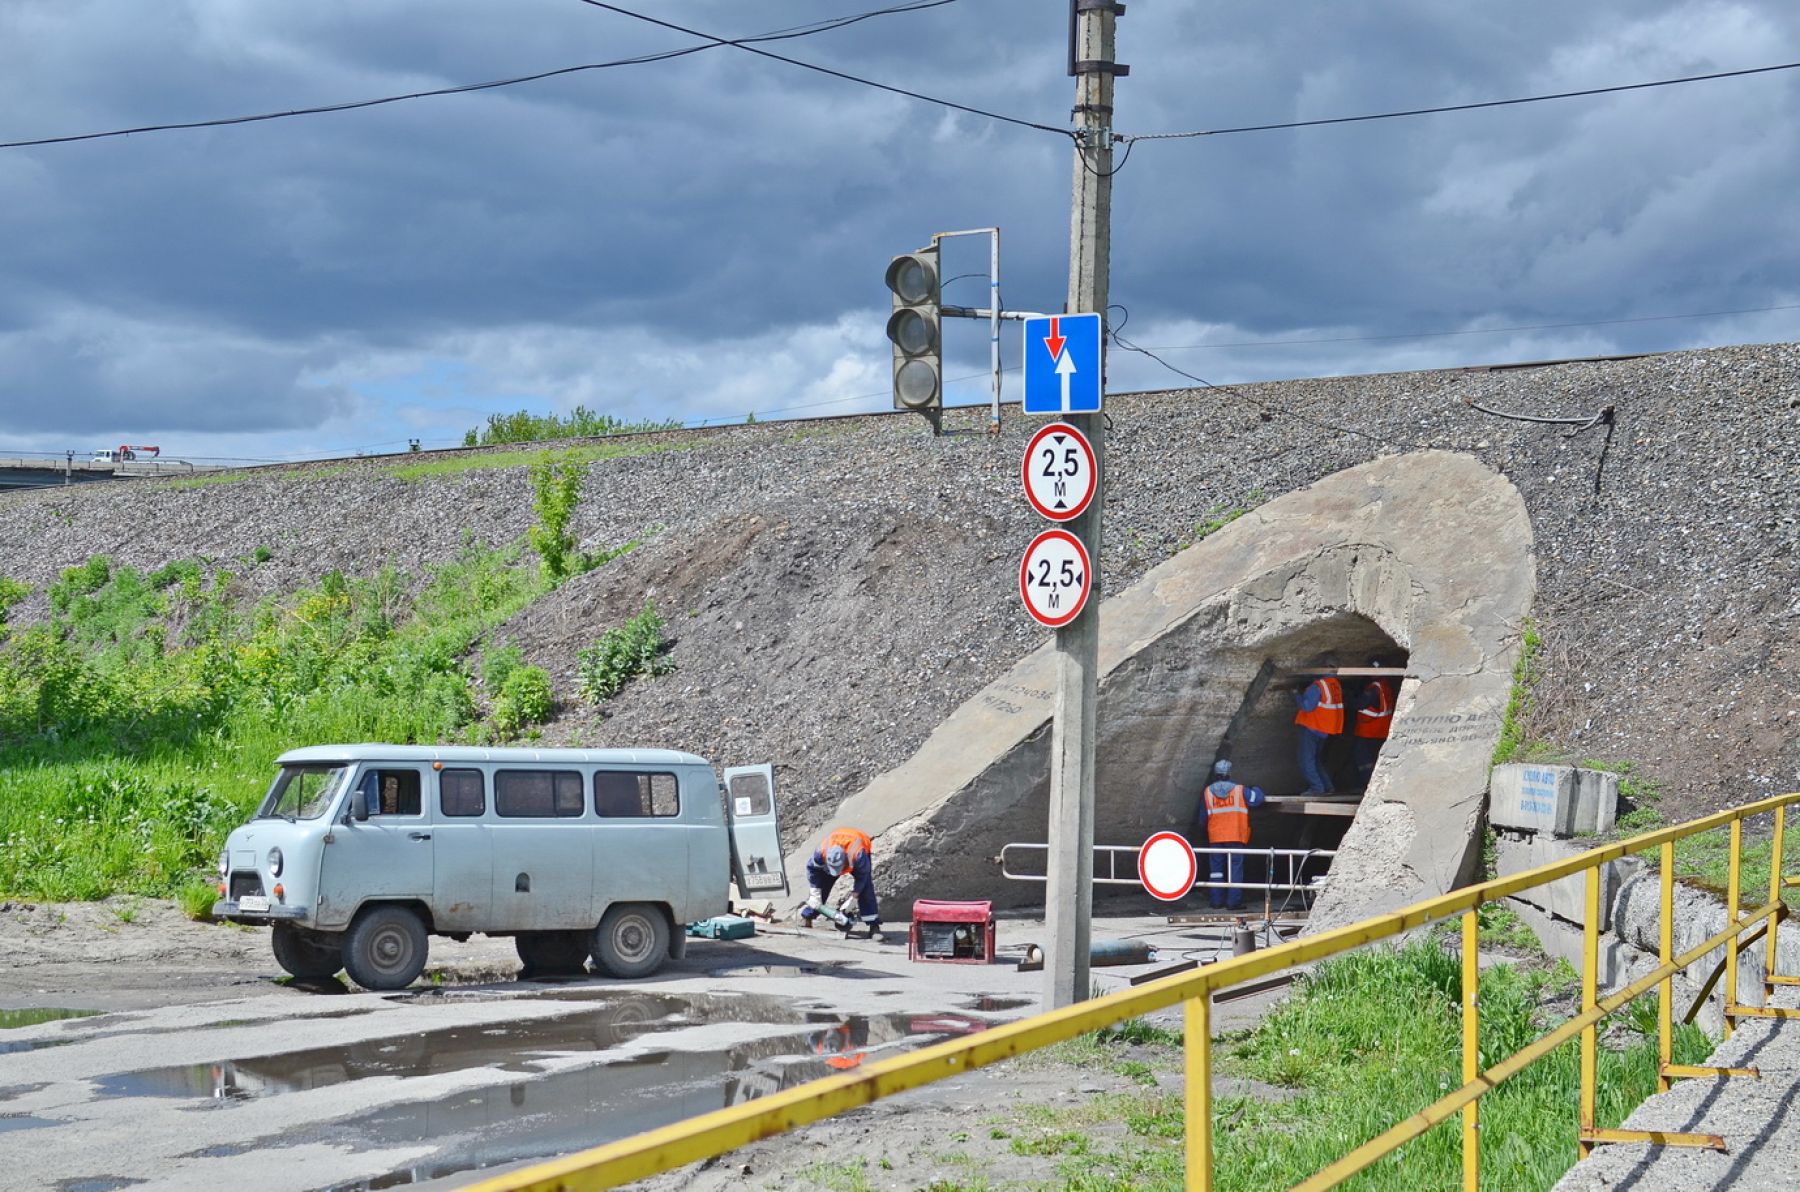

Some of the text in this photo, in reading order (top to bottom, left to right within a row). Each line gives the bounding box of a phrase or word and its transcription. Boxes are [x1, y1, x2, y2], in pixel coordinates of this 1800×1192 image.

[1042, 448, 1079, 482] 2,5
[1038, 559, 1074, 593] 2,5
[1400, 714, 1462, 725] КУПЛЮ
